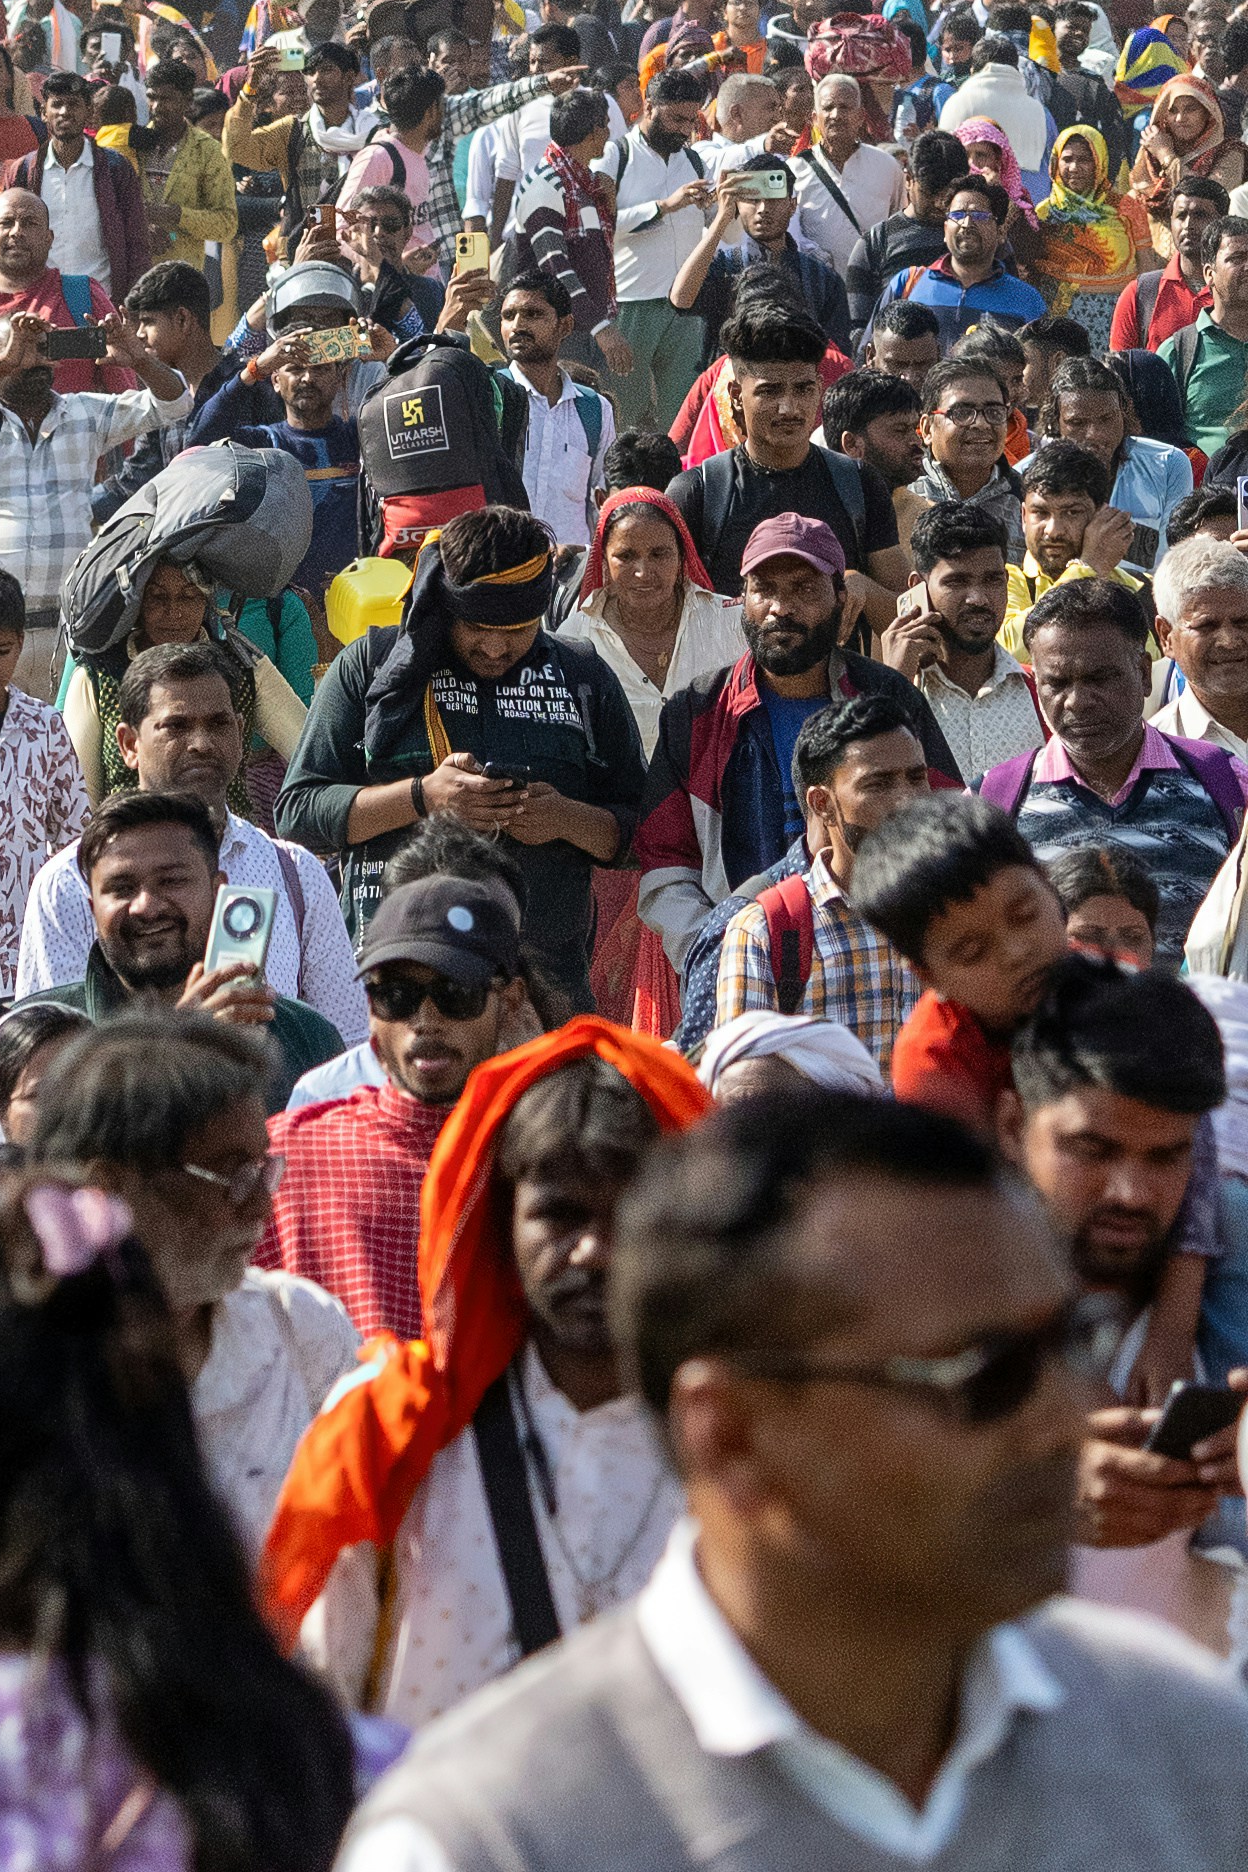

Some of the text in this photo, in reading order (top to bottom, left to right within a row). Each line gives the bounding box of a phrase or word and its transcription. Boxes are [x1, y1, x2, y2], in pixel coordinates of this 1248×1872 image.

[391, 426, 443, 445] UTKARSH
[401, 439, 436, 450] CLASSES
[496, 685, 526, 696] LONG
[529, 685, 545, 698] ON
[545, 700, 566, 713] THE
